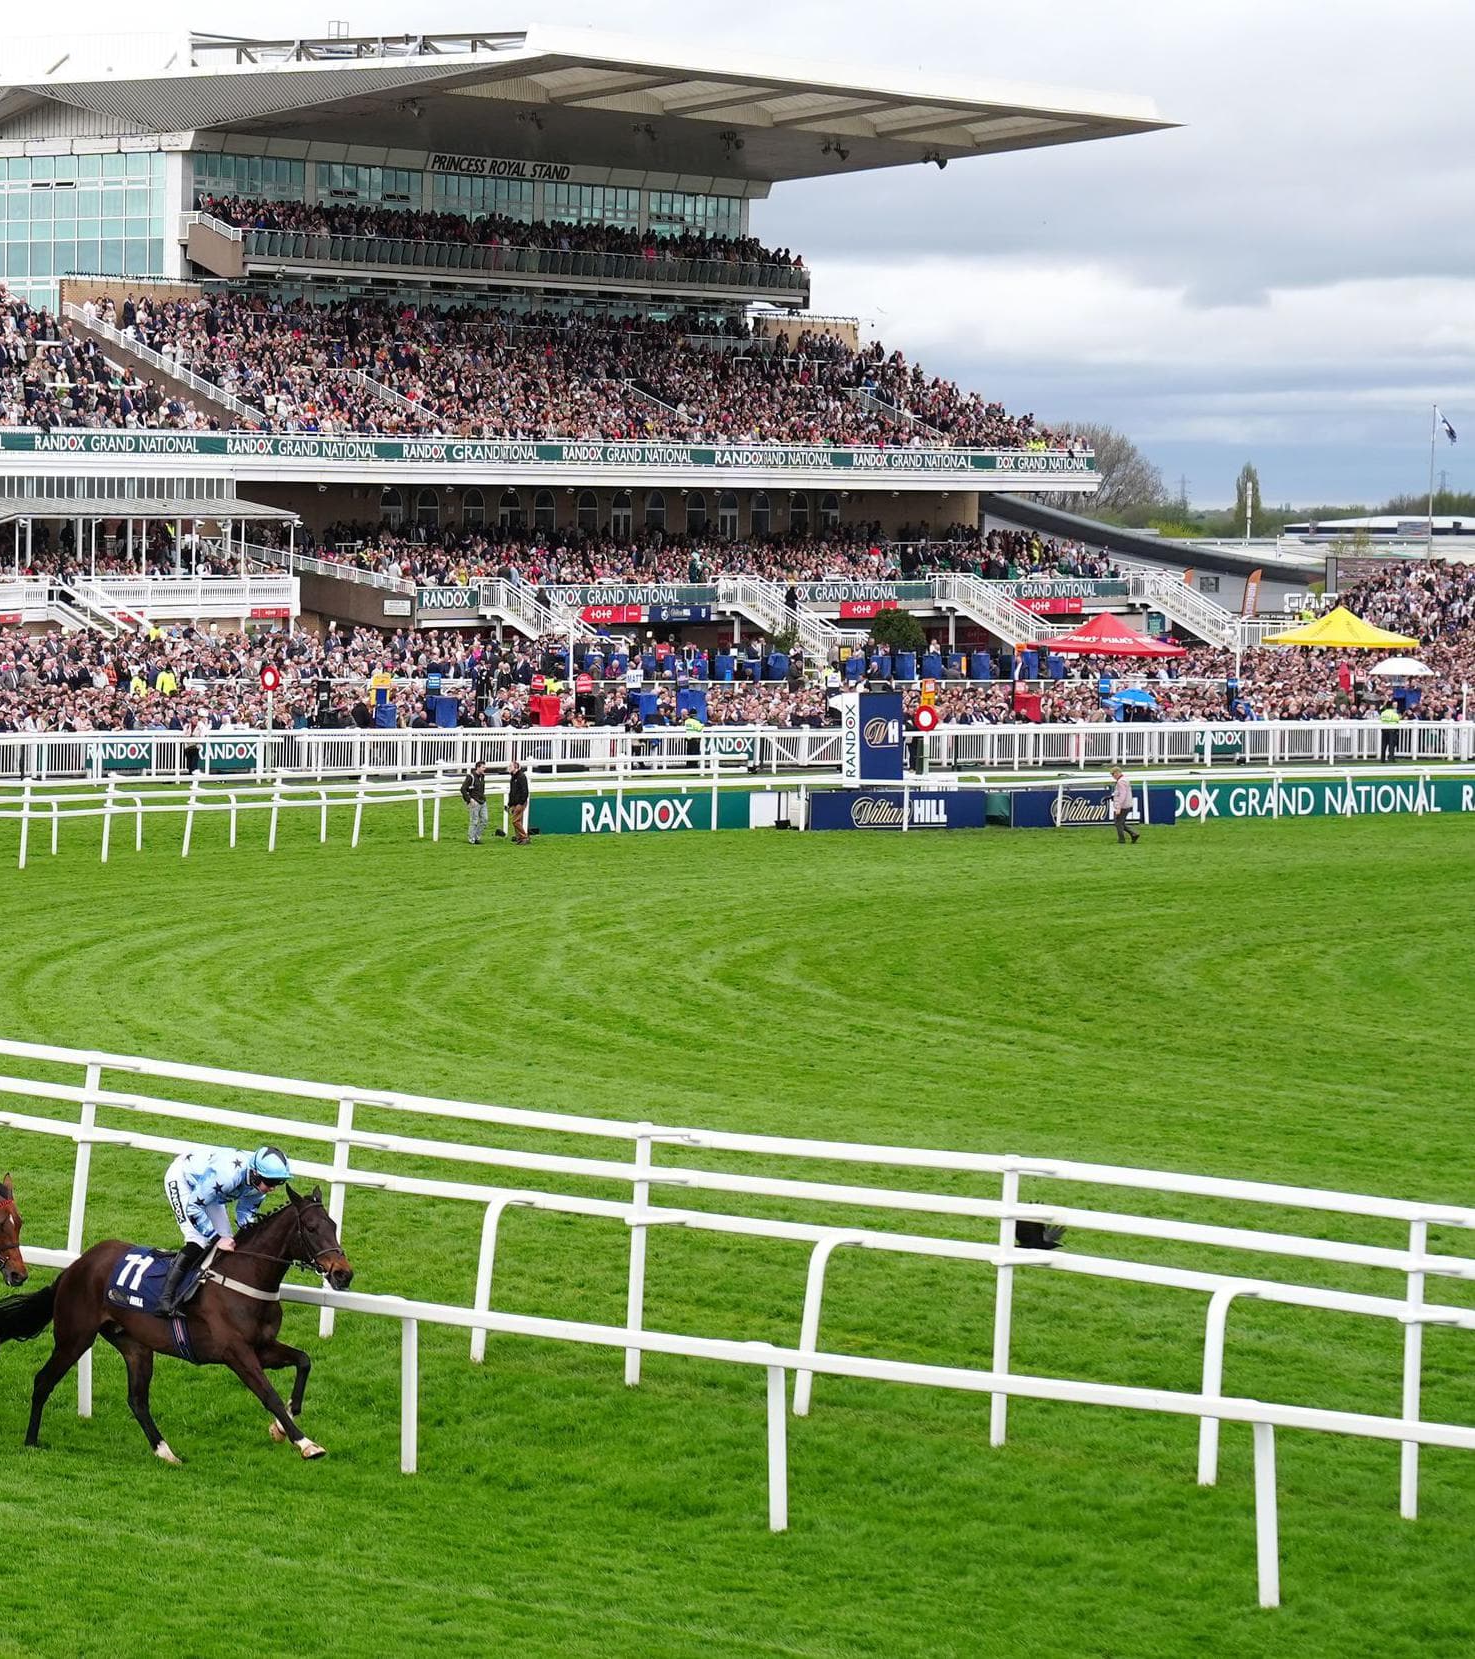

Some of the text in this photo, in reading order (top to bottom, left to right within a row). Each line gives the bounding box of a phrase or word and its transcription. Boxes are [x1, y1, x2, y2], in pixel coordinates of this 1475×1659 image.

[431, 155, 570, 181] PRINCESS ROYAL STAND
[35, 435, 200, 453] RANDOX GRAND NATIONAL
[227, 438, 378, 458] RANDOX GRAND NATIONAL
[403, 443, 446, 459] RANDOX
[453, 444, 500, 460] GRAND
[562, 446, 693, 464] RANDOX GRAND NATIONAL
[715, 450, 763, 465] RANDOX
[788, 452, 833, 465] NATIONAL
[853, 453, 975, 469] RANDOX GRAND NATIONAL
[1018, 457, 1046, 470] GRAND
[1049, 457, 1089, 470] NATIONAL
[422, 590, 470, 607] RANDOX
[587, 589, 624, 604] GRAND
[628, 589, 679, 603] NATIONAL
[815, 587, 848, 600] GRAND
[852, 586, 898, 600] NATIONAL
[1021, 584, 1051, 597] GRAND
[1055, 583, 1096, 597] NATIONAL
[590, 609, 612, 619] tote
[845, 704, 856, 778] RANDOX
[1229, 787, 1315, 817] GRAND
[1325, 785, 1442, 814] NATIONAL
[581, 799, 693, 832] RANDOX
[913, 799, 947, 823] HILL
[169, 1182, 185, 1222] RANDOX
